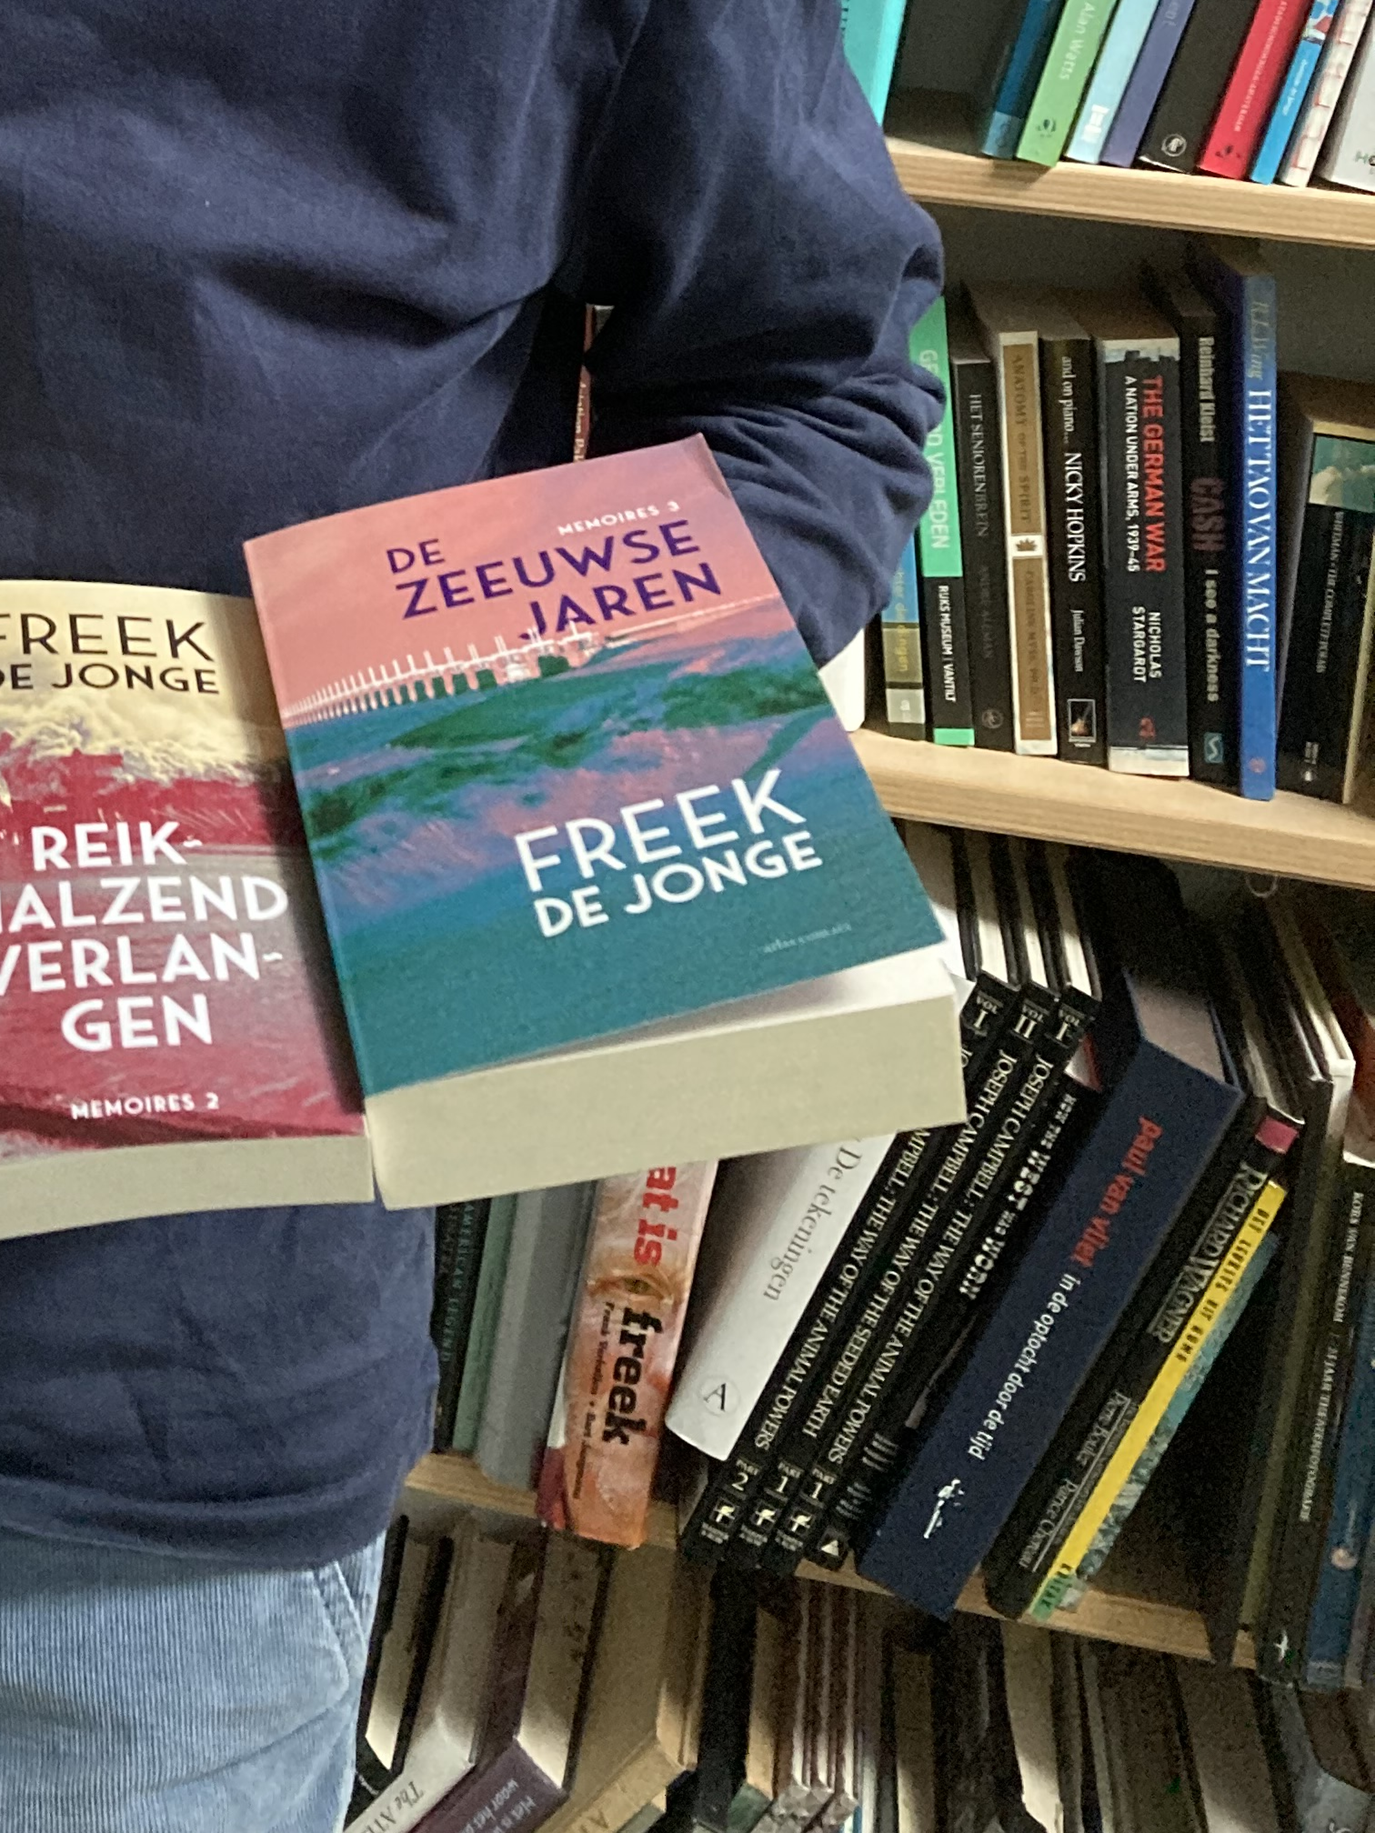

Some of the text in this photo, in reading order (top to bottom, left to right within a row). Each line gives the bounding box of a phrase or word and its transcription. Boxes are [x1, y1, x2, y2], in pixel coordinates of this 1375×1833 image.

[1246, 388, 1274, 457] HET
[1142, 374, 1166, 572] THE GERMAN WAR
[1246, 455, 1274, 518] TAO
[557, 504, 661, 537] MEMOIRES
[1246, 517, 1274, 566] VAN
[386, 537, 447, 576] DE
[394, 518, 702, 620] ZEEUWSE
[518, 560, 725, 641] JAREN
[1246, 571, 1274, 674] MACHT
[1132, 605, 1148, 683] STARGARDT
[1147, 610, 1163, 679] NICHOLAS
[50, 661, 220, 696] JONGE
[30, 820, 204, 872] REIK-
[513, 767, 808, 894] FREEK
[533, 829, 826, 937] DE JONGE
[59, 993, 214, 1053] GEN
[71, 1092, 220, 1121] MEMOIRES 2
[974, 1048, 1018, 1115] JOSEPH
[1007, 1054, 1054, 1118] JOSEPH
[762, 1146, 864, 1303] De tekeningen
[907, 1201, 941, 1236] THE
[939, 1210, 973, 1243] THE
[879, 1270, 903, 1294] OF
[891, 1232, 925, 1271] WAY
[925, 1243, 958, 1279] WAY
[1332, 1191, 1364, 1324] KORS VAN BENNEKOM
[861, 1291, 893, 1326] THE
[893, 1299, 925, 1334] THE
[914, 1278, 937, 1303] OF
[966, 1117, 1164, 1461] paul van vliet in de optocht door de tijd
[752, 1193, 896, 1451] THE WAY OF THE ANIMAL POWERS
[601, 1307, 664, 1446] freek
[826, 1323, 873, 1388] SEEDED
[861, 1333, 903, 1404] ANIMAL
[801, 1381, 843, 1439] EARTH
[826, 1400, 872, 1464] POWERS
